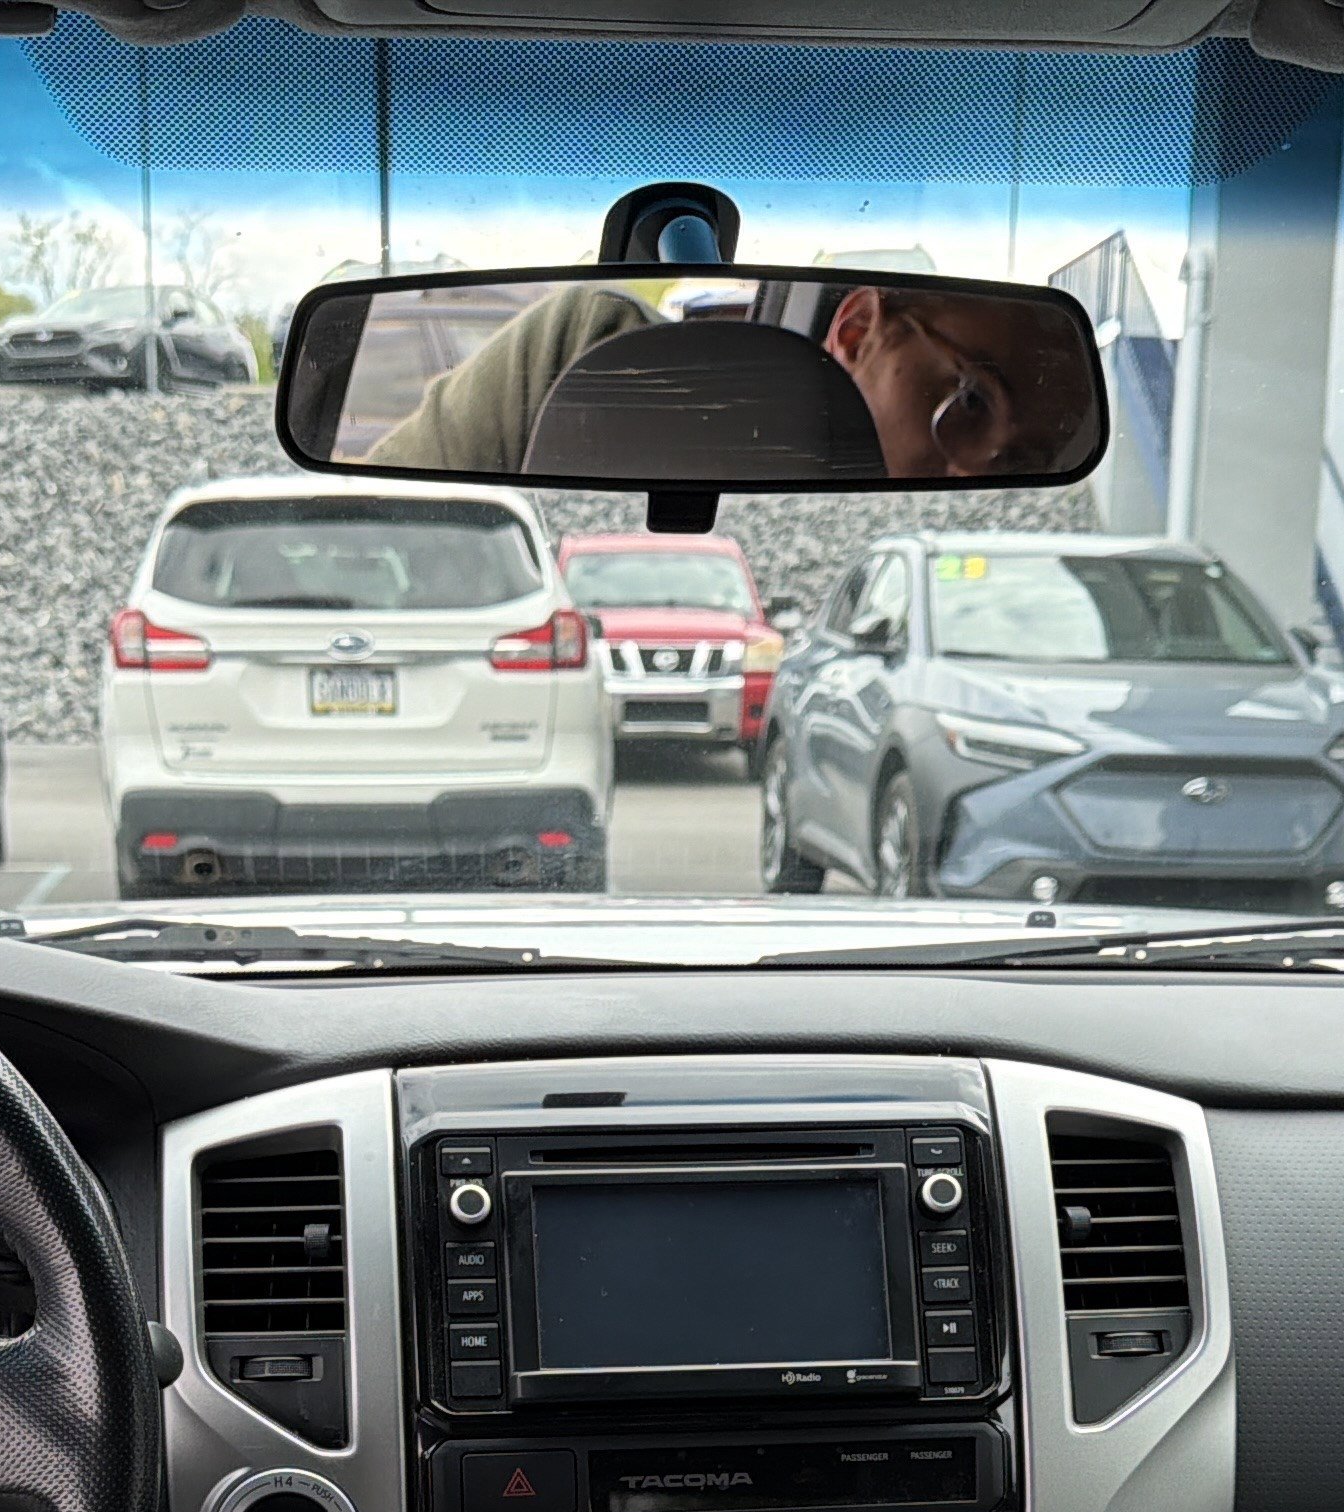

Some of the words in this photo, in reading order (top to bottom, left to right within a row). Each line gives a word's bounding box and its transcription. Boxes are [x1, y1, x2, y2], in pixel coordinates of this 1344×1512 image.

[458, 1254, 485, 1266] AUDIO
[462, 1290, 484, 1301] APPS
[461, 1335, 488, 1347] HOME
[796, 1373, 821, 1382] Radio
[841, 1452, 889, 1462] PASSENGER
[910, 1450, 953, 1460] PASSENGER
[619, 1472, 753, 1489] TACOMA
